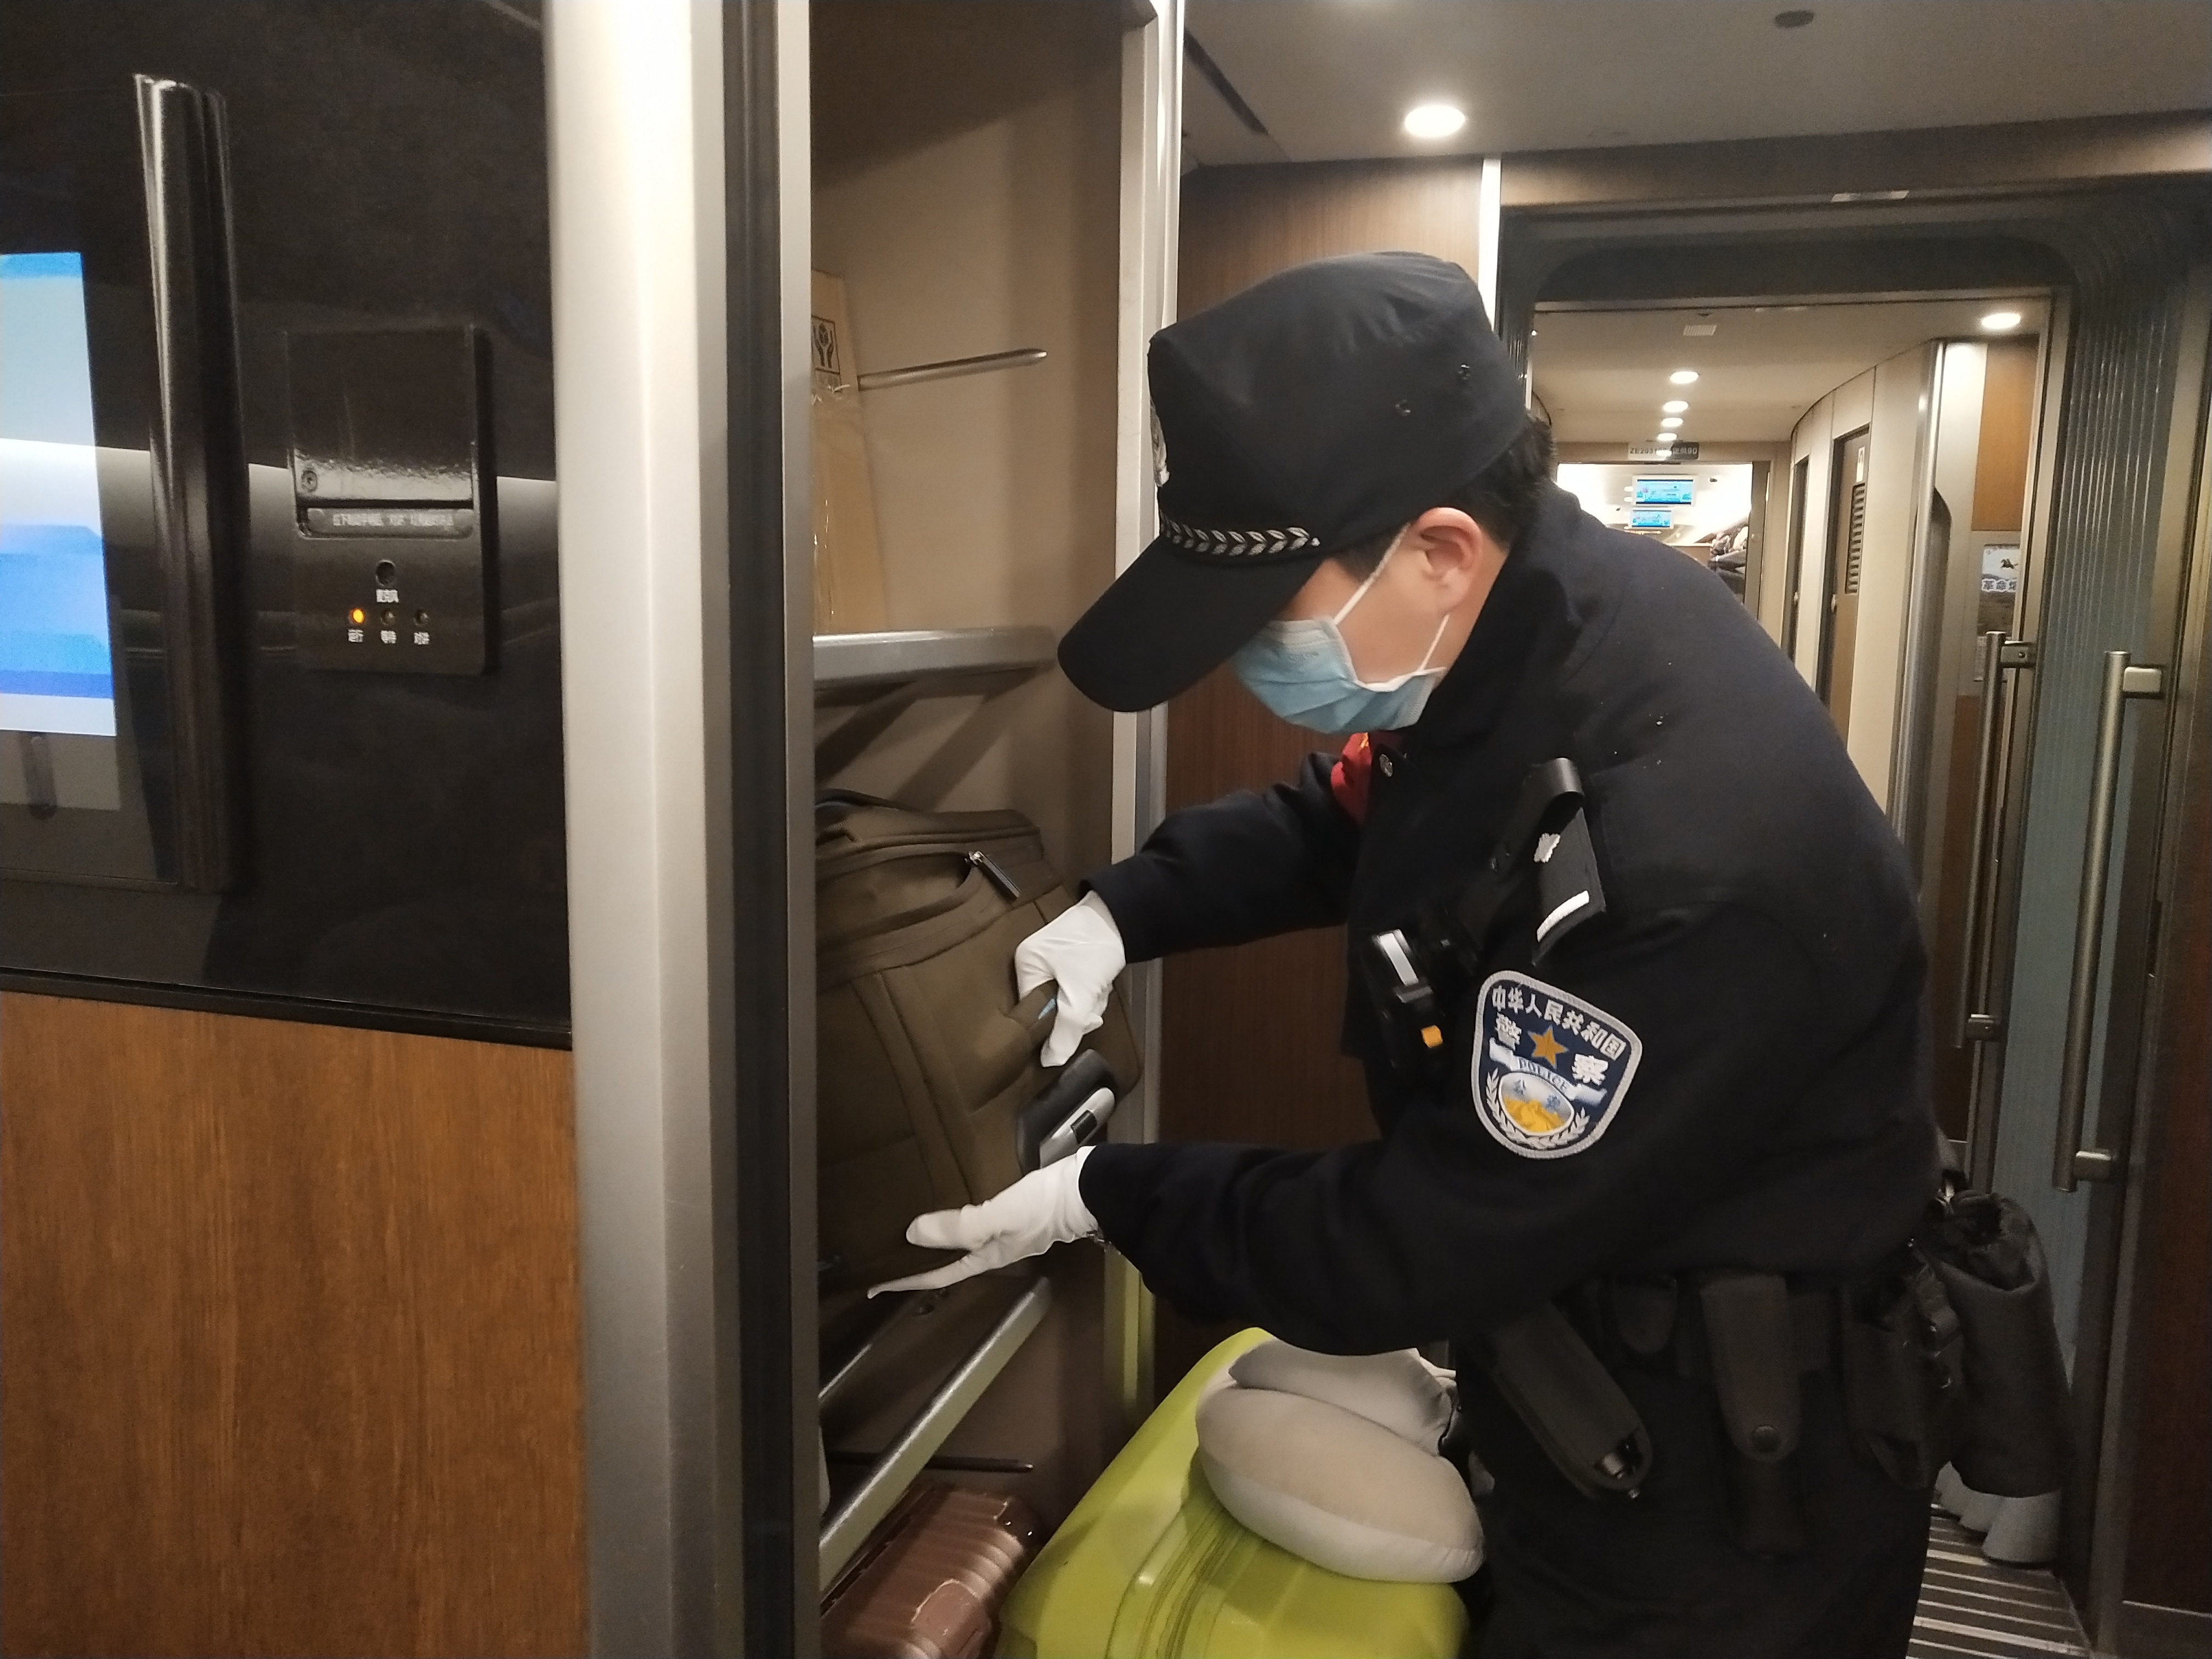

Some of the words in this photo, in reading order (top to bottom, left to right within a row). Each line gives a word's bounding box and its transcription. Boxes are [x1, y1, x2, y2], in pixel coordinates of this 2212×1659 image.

[1491, 985, 1627, 1061] 中华人民共和国
[1495, 1012, 1522, 1050] 警
[1572, 1053, 1609, 1085] 察
[1518, 1058, 1567, 1090] POLICE
